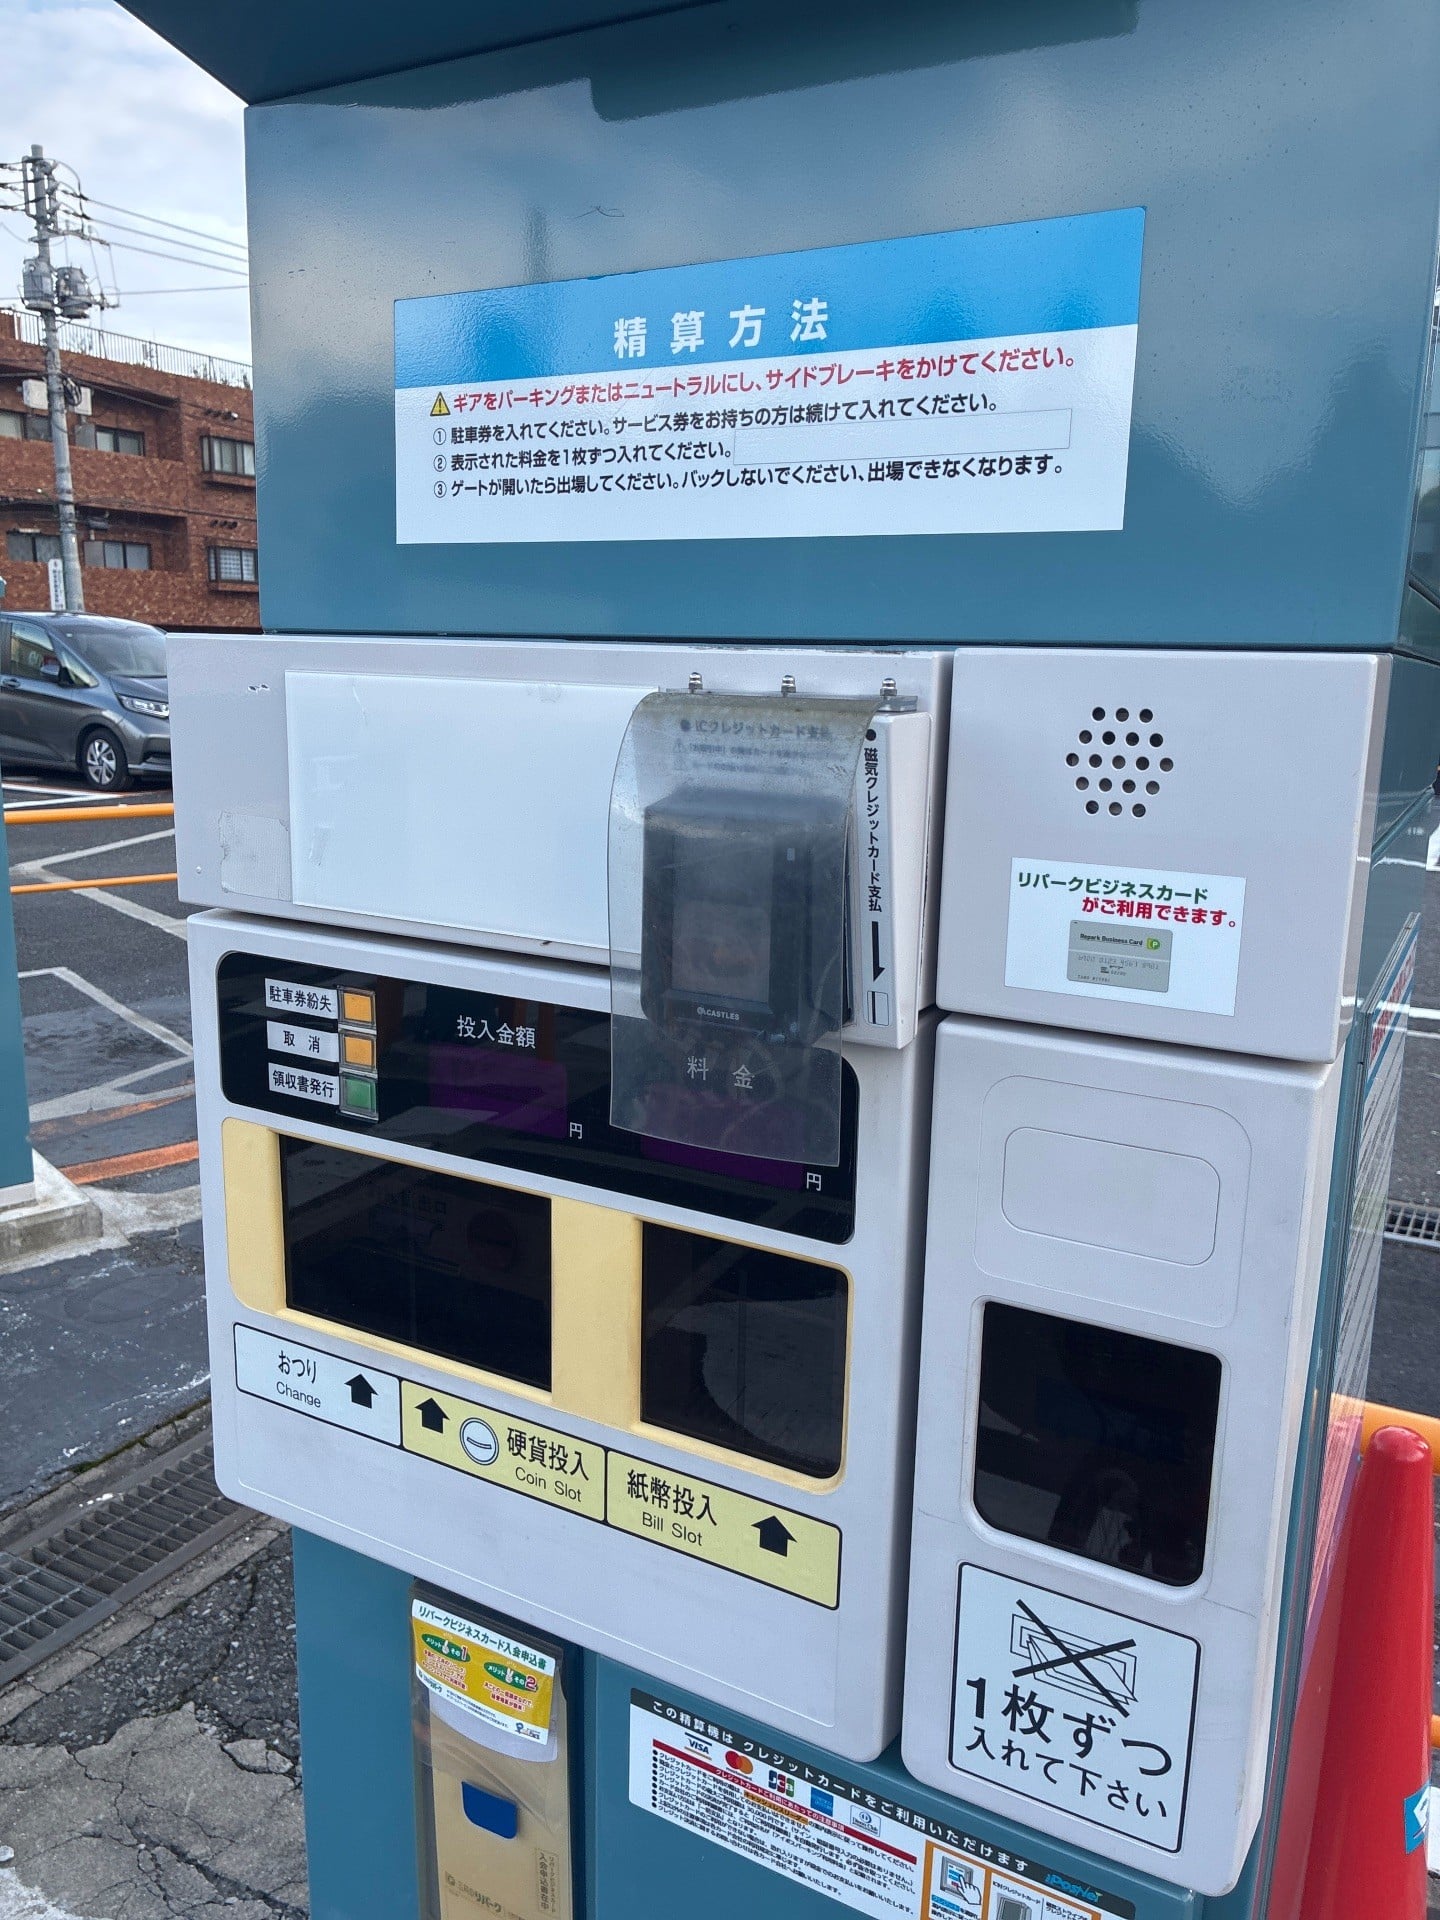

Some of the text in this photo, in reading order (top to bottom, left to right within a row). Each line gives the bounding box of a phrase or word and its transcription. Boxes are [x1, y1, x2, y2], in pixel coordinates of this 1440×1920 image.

[614, 297, 829, 359] 精算方法
[453, 346, 1074, 413] ギアをパーキングまたはニュートラルにし、サイドブレーキをかけてください。
[863, 747, 883, 913] 磁気クレジットカード支払
[1018, 872, 1208, 904] リパークビジネスカード
[1082, 896, 1236, 928] がご利用できます。
[269, 985, 331, 1013] 駐車券紛失
[706, 1008, 740, 1021] CASTLES
[282, 1029, 321, 1053] 取消
[456, 1014, 536, 1049] 投入金額
[272, 1069, 335, 1098] 領収書発行
[687, 1055, 755, 1090] 料金
[569, 1121, 583, 1140] 円
[806, 1172, 822, 1192] 円
[278, 1350, 317, 1384] おつり
[276, 1381, 321, 1408] Change
[507, 1427, 589, 1481] 硬貨投入
[515, 1467, 582, 1503] Coin Slot
[627, 1469, 718, 1526] 紙幣投入
[642, 1512, 703, 1547] Bill Slot
[966, 1676, 1173, 1777] 1枚ずつ
[688, 1738, 710, 1754] VISA
[769, 1772, 794, 1795] JCB
[966, 1726, 1168, 1818] 入れて下さい
